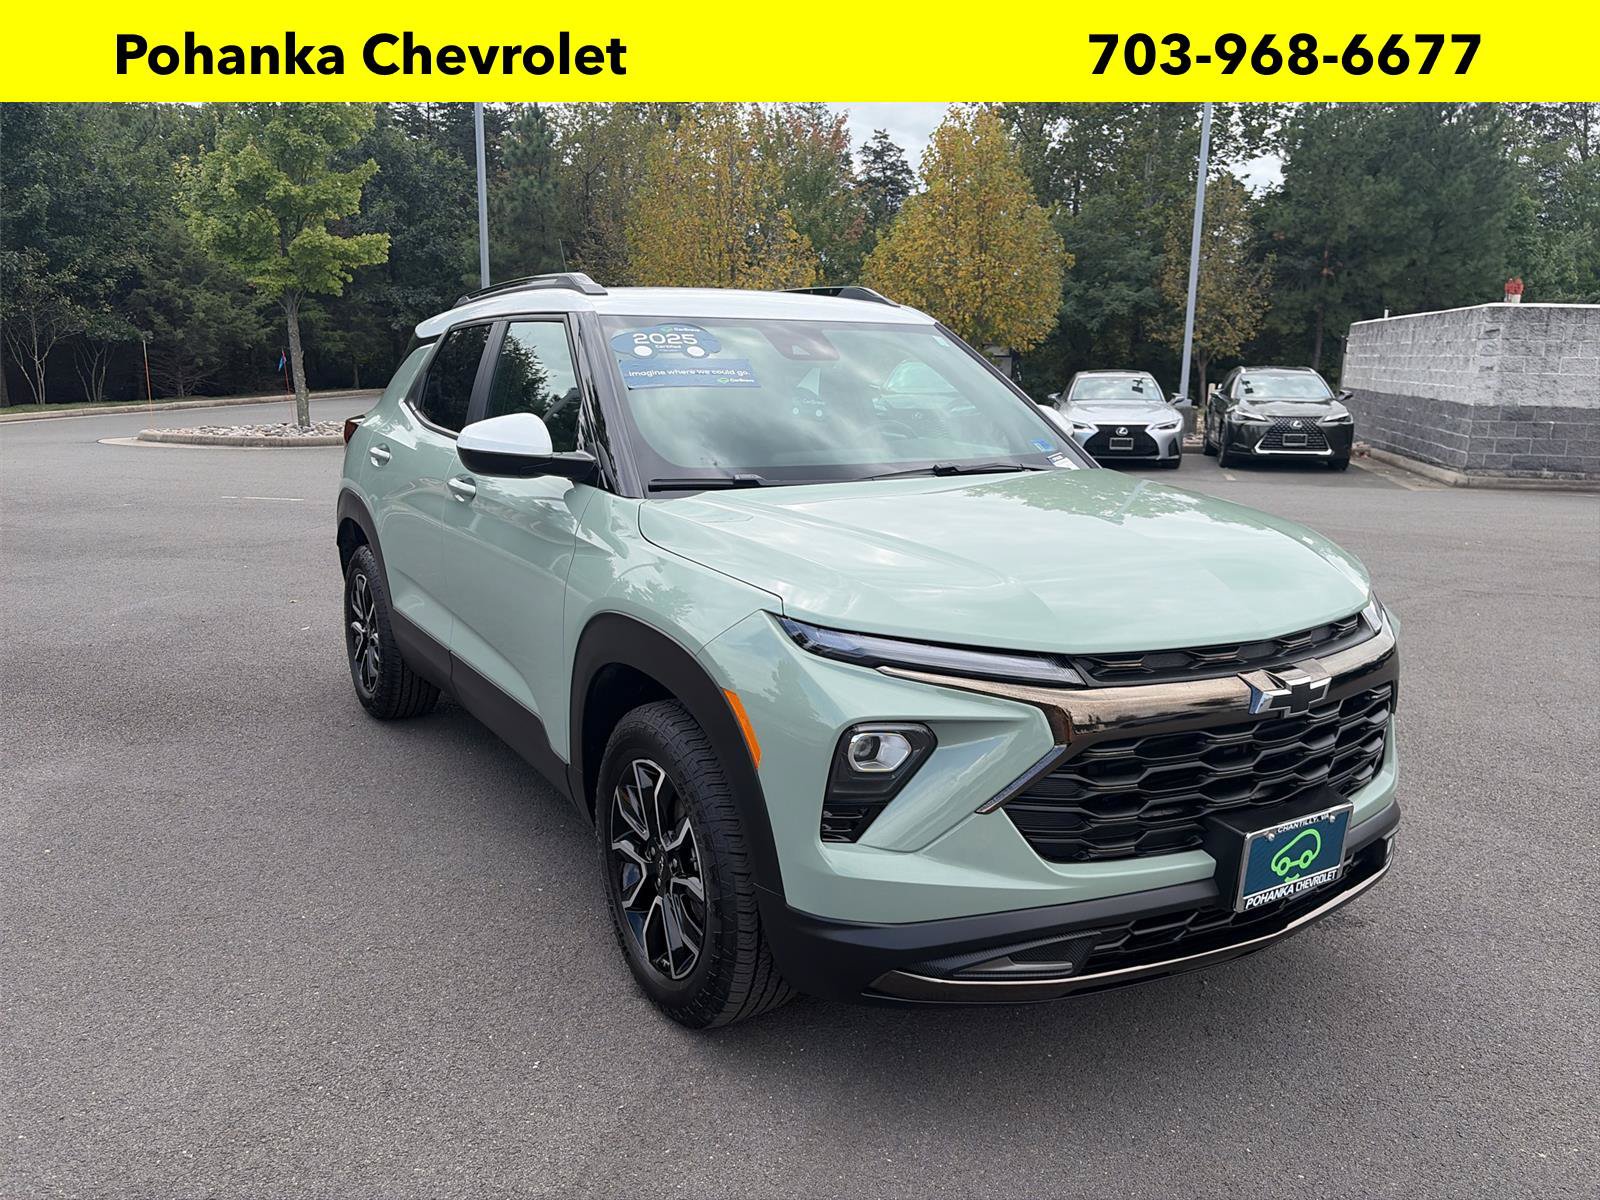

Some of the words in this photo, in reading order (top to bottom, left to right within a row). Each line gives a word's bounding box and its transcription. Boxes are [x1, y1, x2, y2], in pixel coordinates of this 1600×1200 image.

[633, 333, 698, 345] 2025
[1245, 884, 1294, 909] POHANKA
[1295, 869, 1338, 892] CHEVROLET
